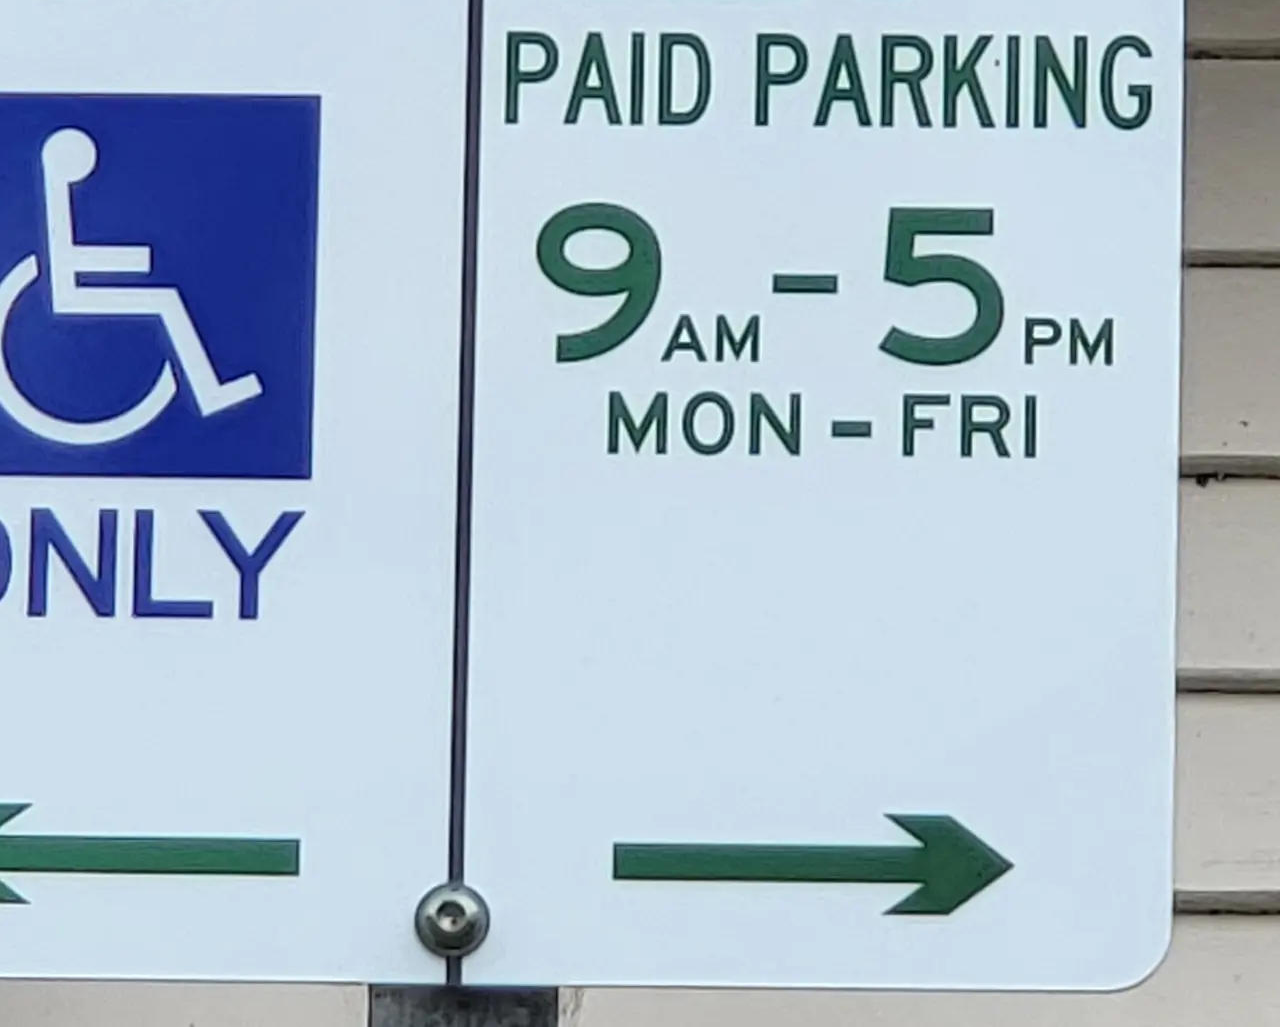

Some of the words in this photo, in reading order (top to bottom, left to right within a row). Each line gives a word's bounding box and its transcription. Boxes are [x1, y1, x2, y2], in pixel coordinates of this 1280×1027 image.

[503, 30, 712, 127] PAID
[753, 32, 1154, 132] PARKING
[606, 390, 802, 457] MON
[901, 392, 1038, 460] FRI
